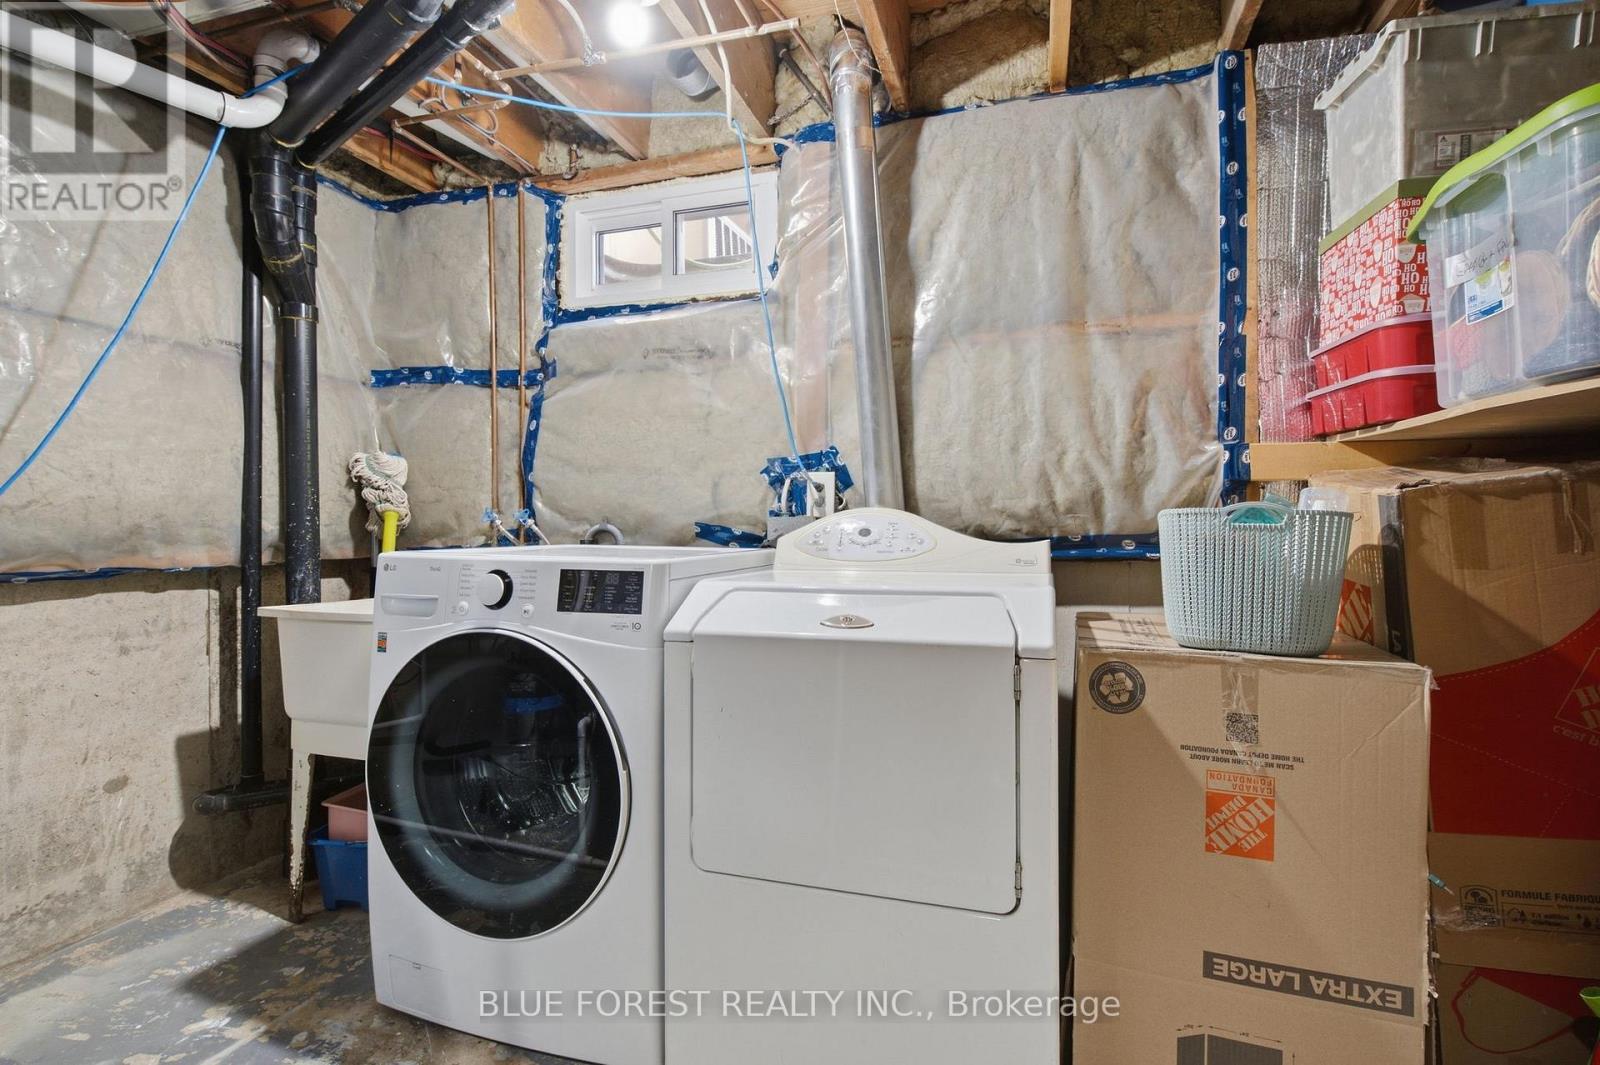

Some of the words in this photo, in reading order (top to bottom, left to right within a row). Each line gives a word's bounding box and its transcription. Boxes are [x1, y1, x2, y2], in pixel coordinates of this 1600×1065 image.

[1404, 264, 1416, 272] HO
[1402, 272, 1420, 285] HO
[1404, 284, 1416, 292] HO
[1180, 744, 1218, 754] FOUNDATION
[1220, 748, 1246, 757] CNADA
[1248, 751, 1270, 760] DEPOT
[1272, 754, 1290, 762] HOME
[1208, 772, 1272, 786] FOUNDATION
[1232, 782, 1272, 794] CANADA
[1206, 795, 1247, 831] DEPOT
[1206, 797, 1274, 854] HOME
[1238, 828, 1268, 852] THE
[1501, 890, 1552, 902] FORMULE
[1212, 958, 1300, 991] LARGE
[1309, 976, 1402, 1010] EXTRA
